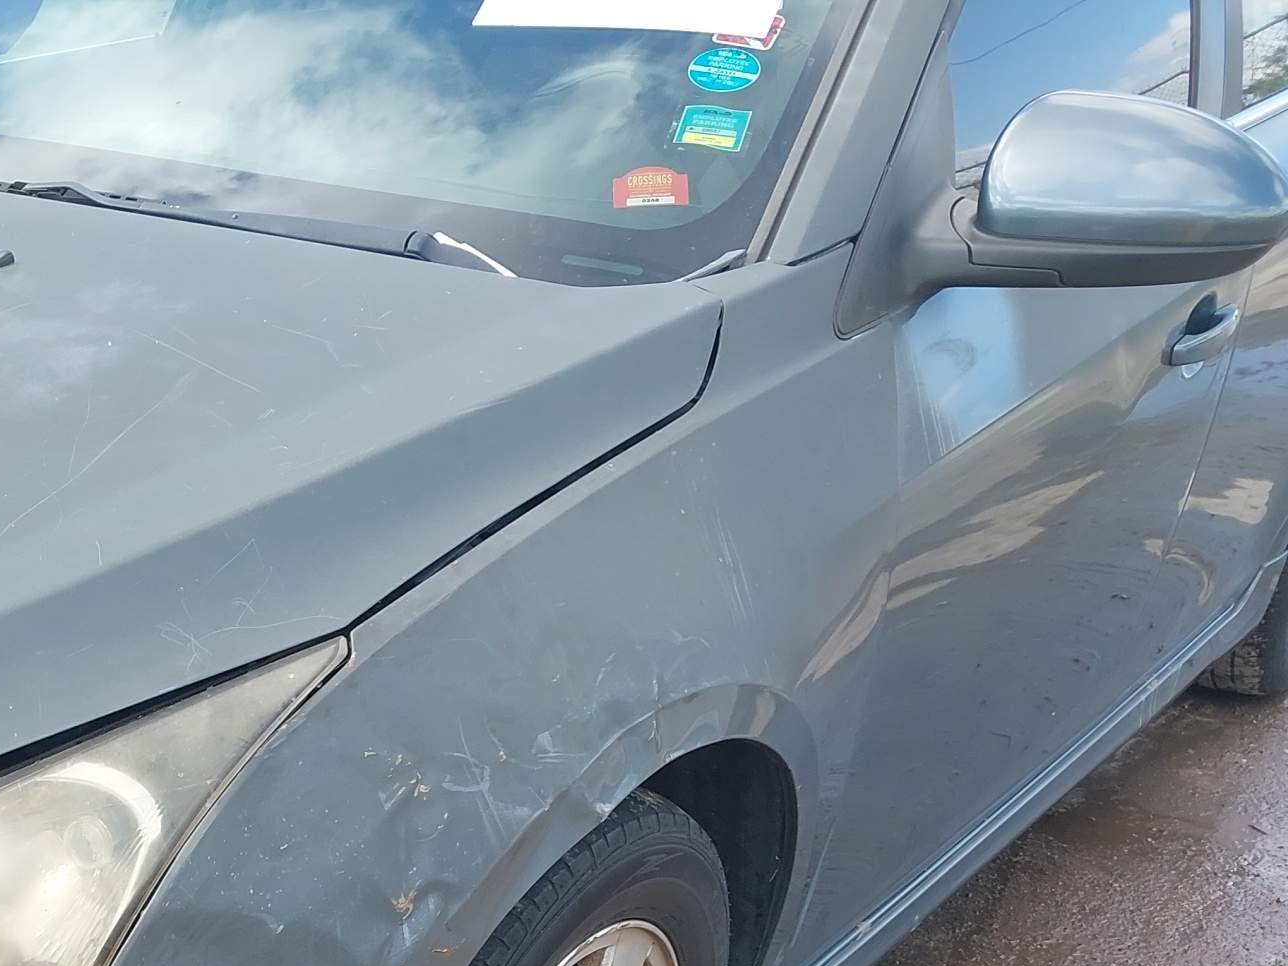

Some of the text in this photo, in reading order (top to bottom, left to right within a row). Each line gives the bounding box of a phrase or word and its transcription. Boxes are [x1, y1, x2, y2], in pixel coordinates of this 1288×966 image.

[708, 62, 744, 71] PARKING
[692, 119, 734, 128] PARKING
[627, 174, 673, 186] CROSSINGS
